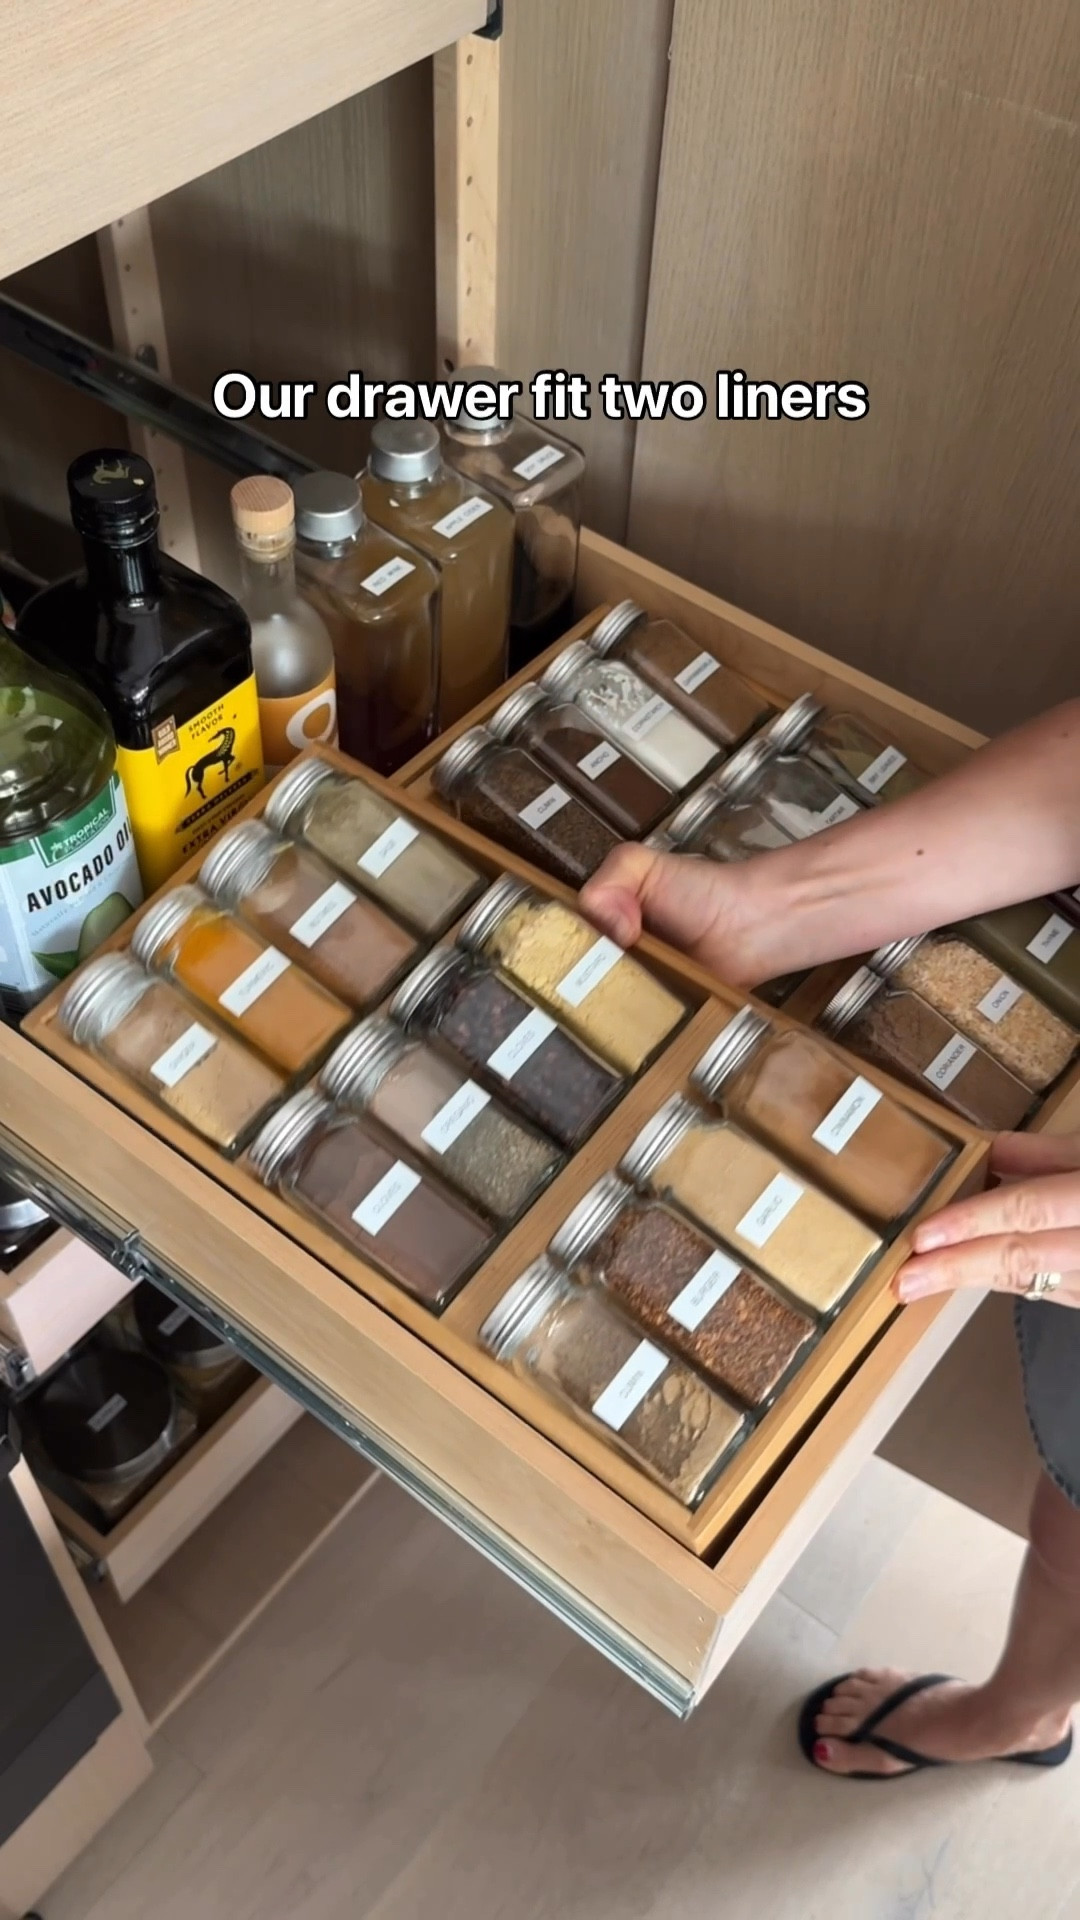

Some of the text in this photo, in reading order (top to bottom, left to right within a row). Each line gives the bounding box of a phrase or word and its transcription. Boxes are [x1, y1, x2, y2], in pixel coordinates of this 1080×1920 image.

[188, 703, 225, 733] SMOOTH
[191, 713, 224, 741] FLAVOR
[536, 795, 558, 815] CUMIN
[824, 805, 846, 826] TARTAR
[62, 807, 109, 846] TROPICAL
[26, 844, 115, 913] AVOCADO
[990, 988, 1010, 1010] ONION
[934, 1042, 966, 1080] CORIANDER
[829, 1093, 866, 1138] CINNAMON
[754, 1193, 784, 1228] GARLIC
[689, 1269, 722, 1308] BURGER
